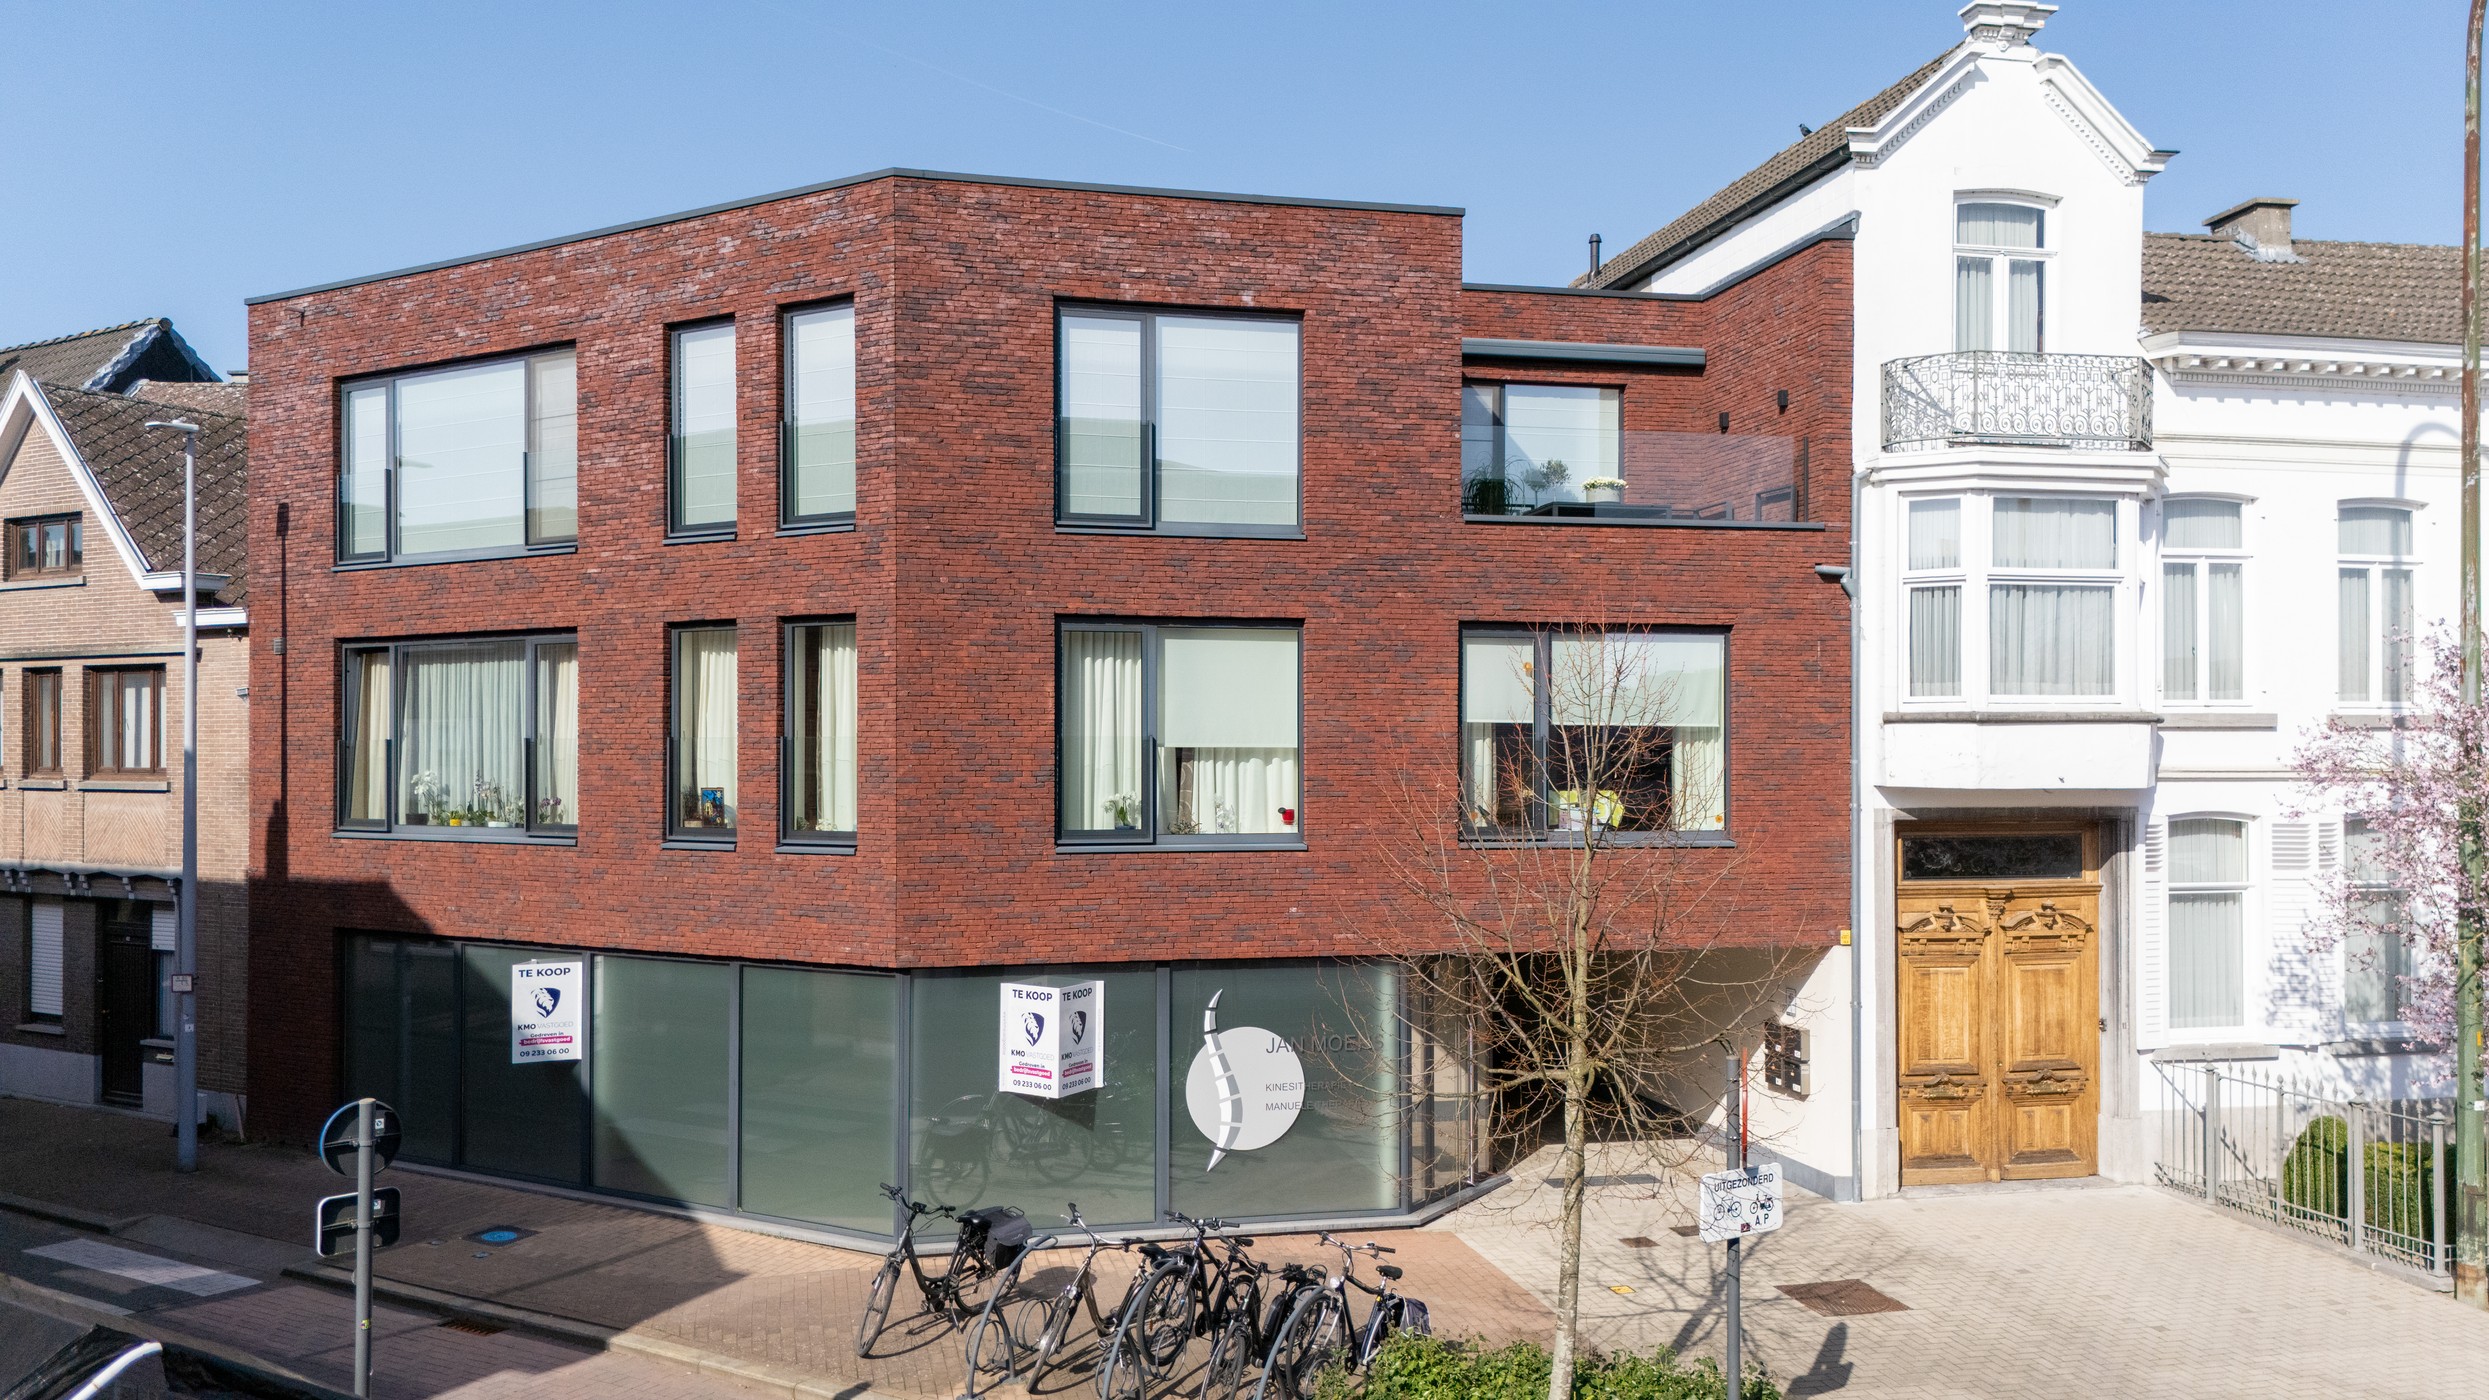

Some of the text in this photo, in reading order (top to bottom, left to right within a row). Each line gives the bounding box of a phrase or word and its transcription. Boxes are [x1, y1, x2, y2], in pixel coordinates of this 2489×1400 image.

[518, 967, 571, 977] TE KOOP
[1012, 989, 1052, 1001] TE KOOP
[1062, 987, 1093, 1002] TE KOOP
[517, 1021, 574, 1031] KMO VASTGOED
[1265, 1034, 1305, 1054] JAN
[1011, 1049, 1026, 1057] KMO
[1061, 1052, 1072, 1060] KMO
[1021, 1080, 1033, 1088] 233
[1068, 1080, 1077, 1088] 233
[1078, 1078, 1084, 1086] 06
[1084, 1076, 1091, 1084] 00
[1714, 1173, 1774, 1192] UITGEZONDERD
[1755, 1213, 1769, 1226] A P
